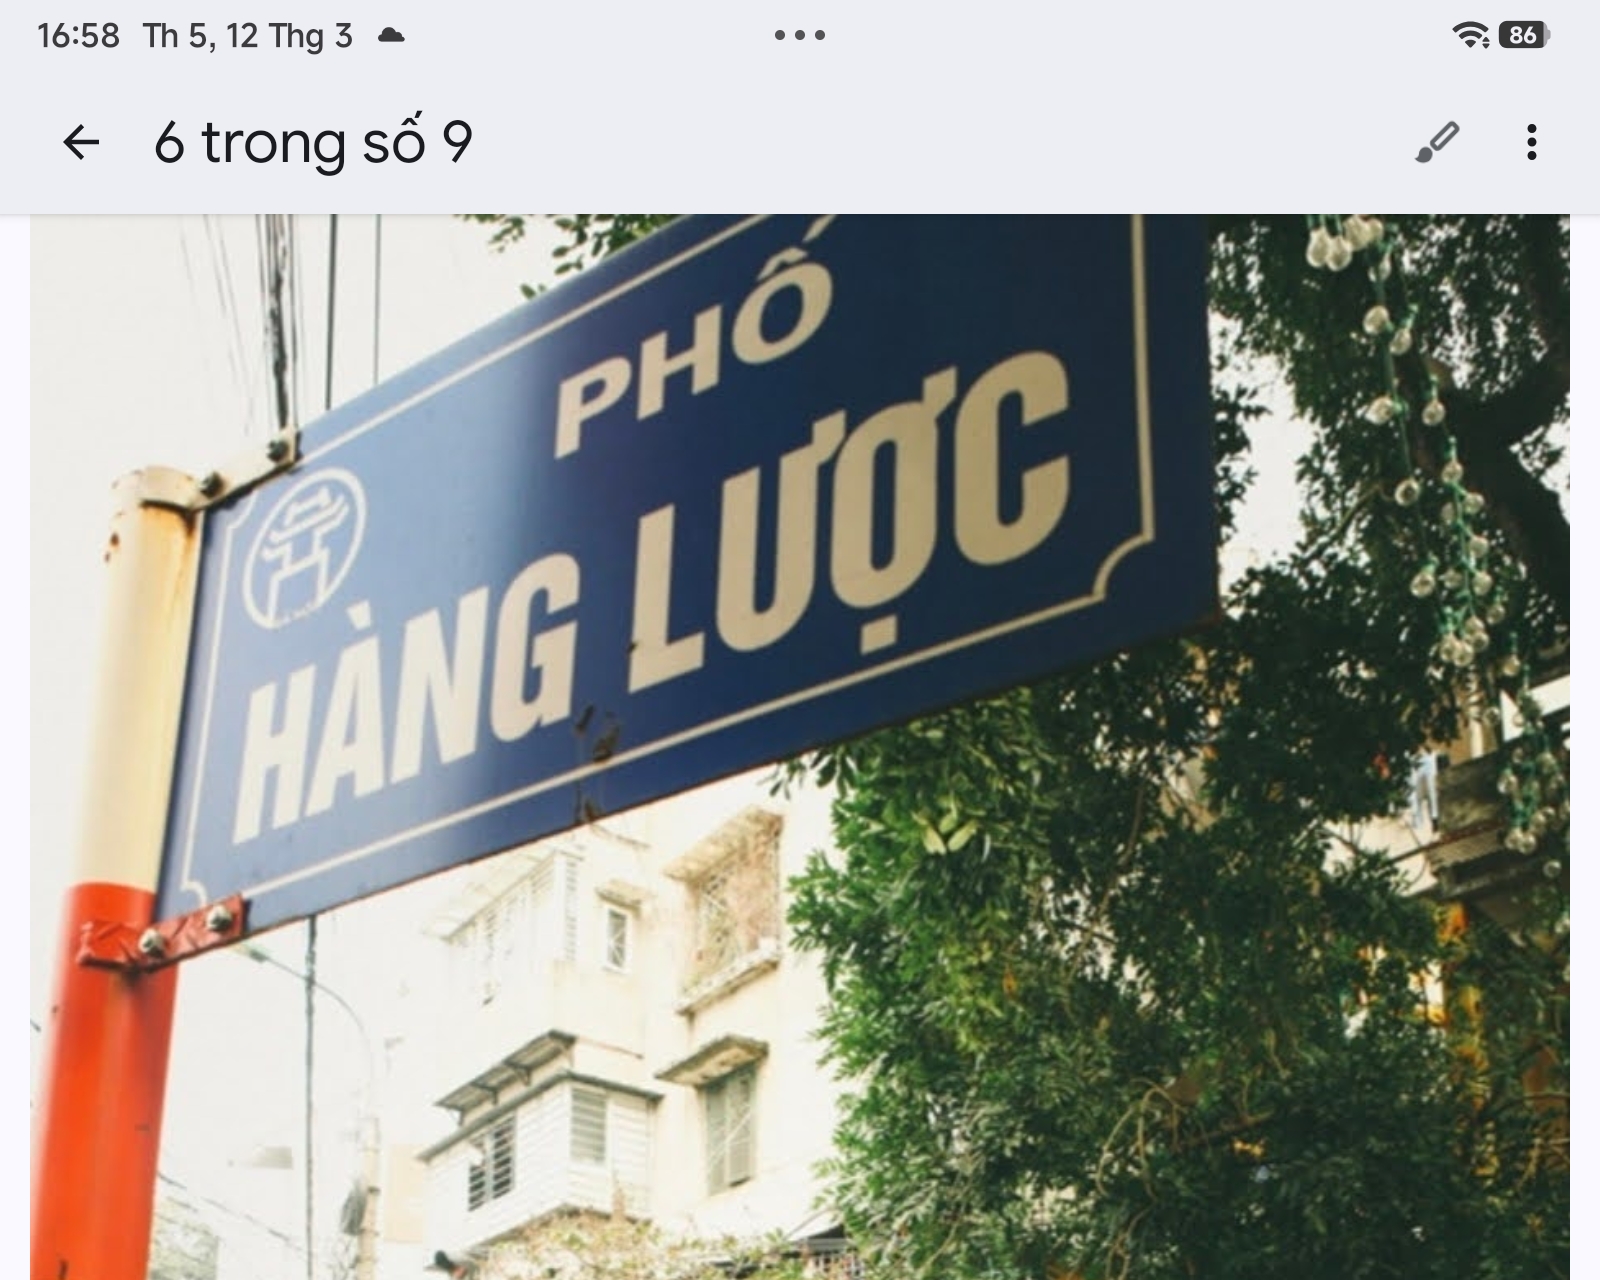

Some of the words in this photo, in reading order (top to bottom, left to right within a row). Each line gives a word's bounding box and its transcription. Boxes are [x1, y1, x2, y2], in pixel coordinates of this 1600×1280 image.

[38, 22, 120, 49] 16:58
[142, 22, 178, 48] Th
[189, 22, 216, 54] 5,
[227, 22, 258, 48] 12
[268, 22, 324, 55] Thg
[335, 22, 353, 49] 3
[1509, 25, 1537, 45] 86
[155, 119, 185, 164] 6
[201, 122, 345, 177] trong
[363, 110, 426, 164] số
[443, 119, 473, 164] 9
[555, 214, 837, 460] PHỐ
[232, 553, 581, 845] HÀNG
[627, 350, 1070, 695] LƯỢC
